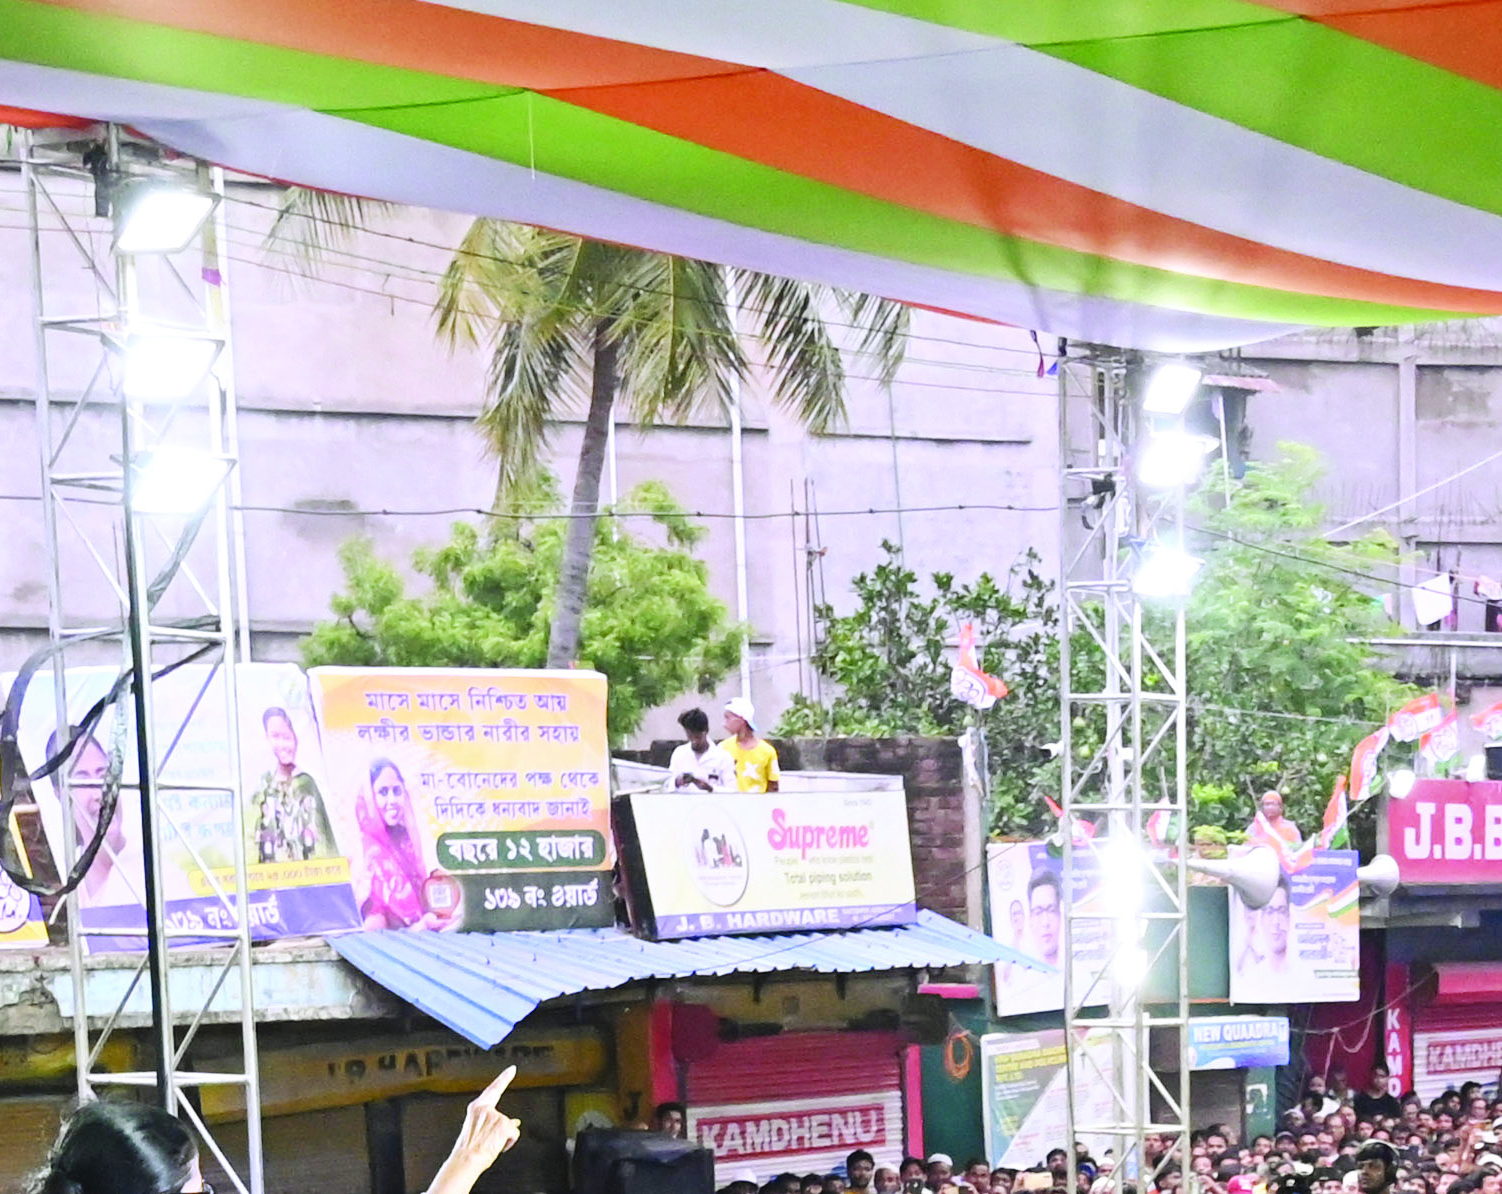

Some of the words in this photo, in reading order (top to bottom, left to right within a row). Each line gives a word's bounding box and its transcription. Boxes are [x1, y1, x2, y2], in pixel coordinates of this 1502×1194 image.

[365, 693, 410, 711] মাসে
[417, 693, 461, 711] মাসে
[467, 686, 528, 711] নিশ্চিত
[533, 692, 567, 712] আয়
[483, 717, 531, 743] নারীর
[537, 724, 580, 743] সহায়
[421, 771, 518, 788] মা-বোনেদের
[525, 772, 553, 788] পক্ষ
[560, 771, 600, 789] থেকে
[434, 795, 487, 820] দিদিকে
[492, 800, 541, 820] ধন্যবাদ
[545, 797, 592, 820] জানাই
[767, 807, 870, 860] Supreme
[444, 837, 499, 865] বছরে
[505, 837, 534, 861] ১২
[536, 835, 595, 862] হাজার
[483, 885, 522, 911] ১৩৯
[523, 884, 548, 908] নং
[551, 877, 599, 908] ওয়ার্ড
[727, 908, 841, 929] HARDWARE
[701, 1110, 879, 1156] KAMDHENU
